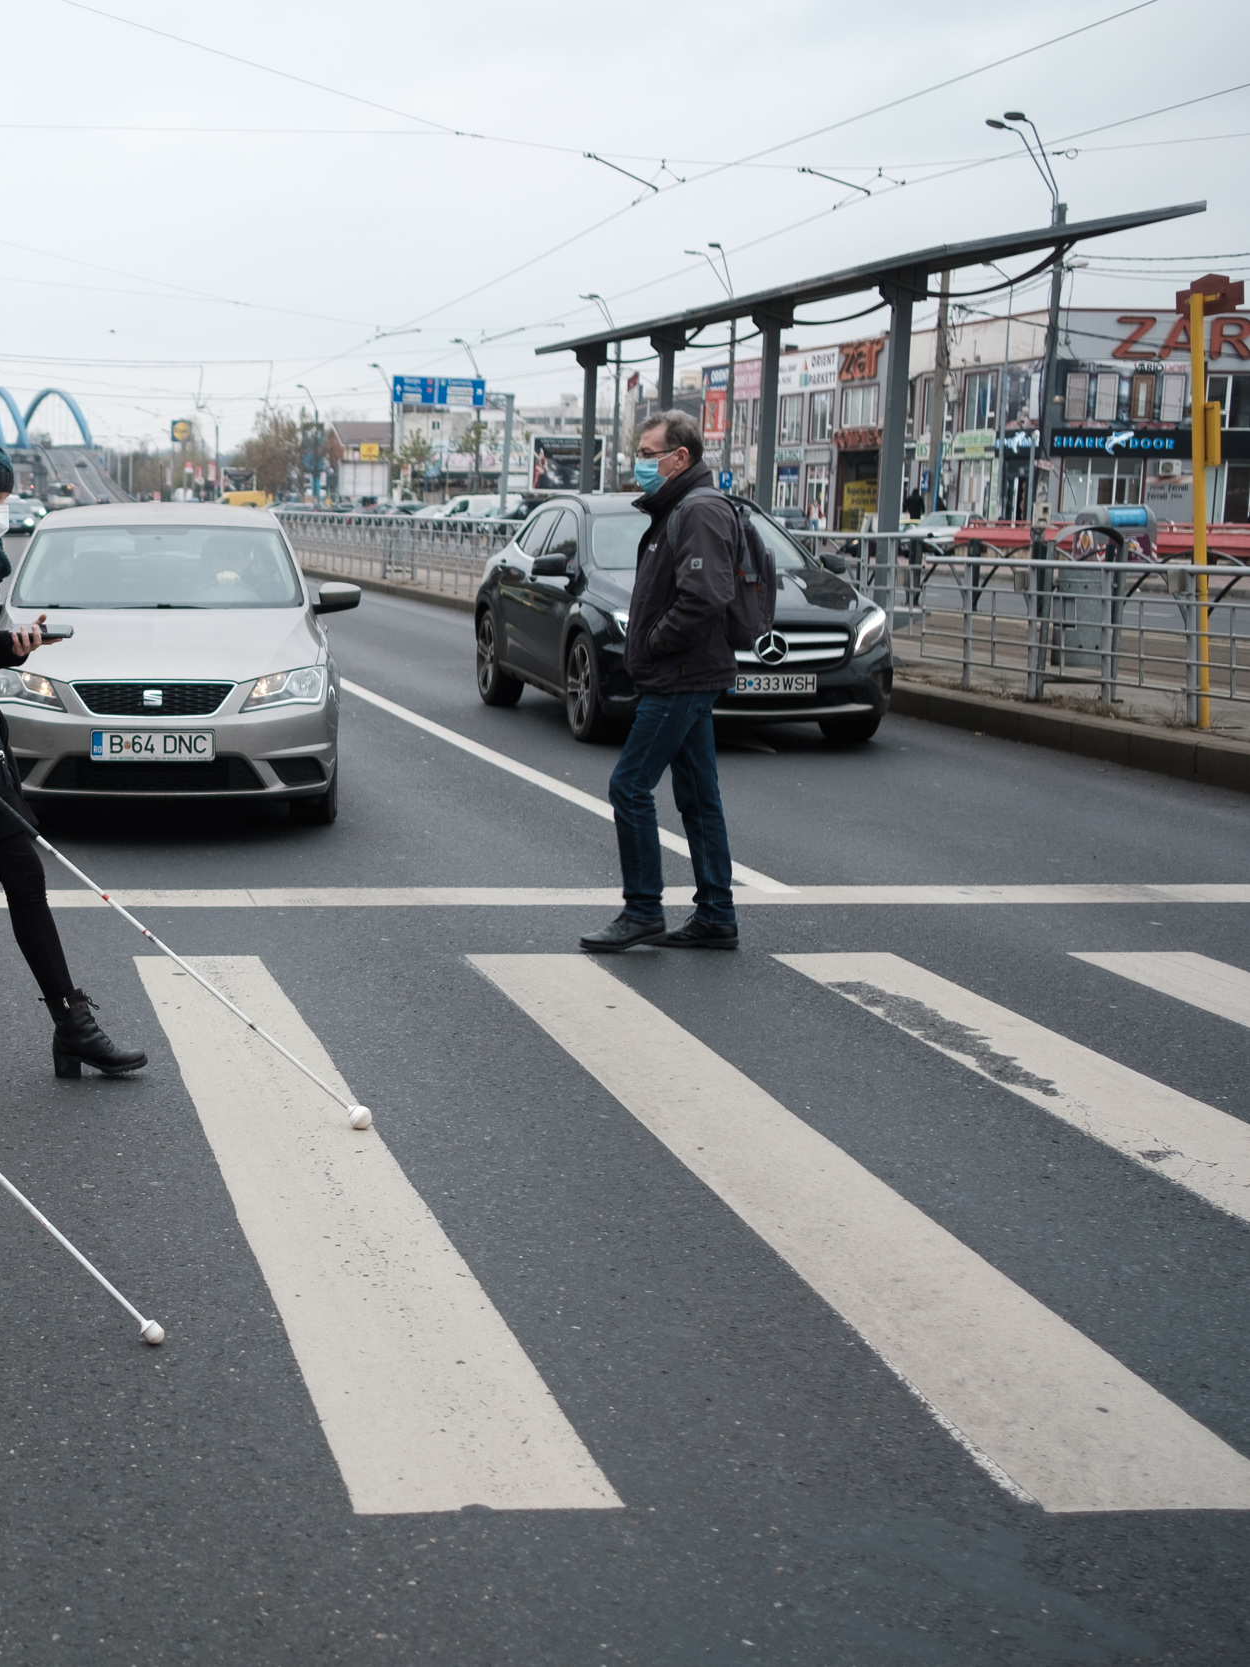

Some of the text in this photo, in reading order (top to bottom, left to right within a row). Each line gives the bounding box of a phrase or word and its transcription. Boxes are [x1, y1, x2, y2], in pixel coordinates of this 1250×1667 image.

[811, 353, 836, 369] ORIENT
[808, 371, 836, 386] PARKETT
[1053, 435, 1106, 449] SHARK
[1129, 436, 1176, 450] DOOR
[737, 676, 815, 691] B 333 WSH
[93, 745, 103, 753] RO
[110, 734, 207, 754] B 64 DNC
